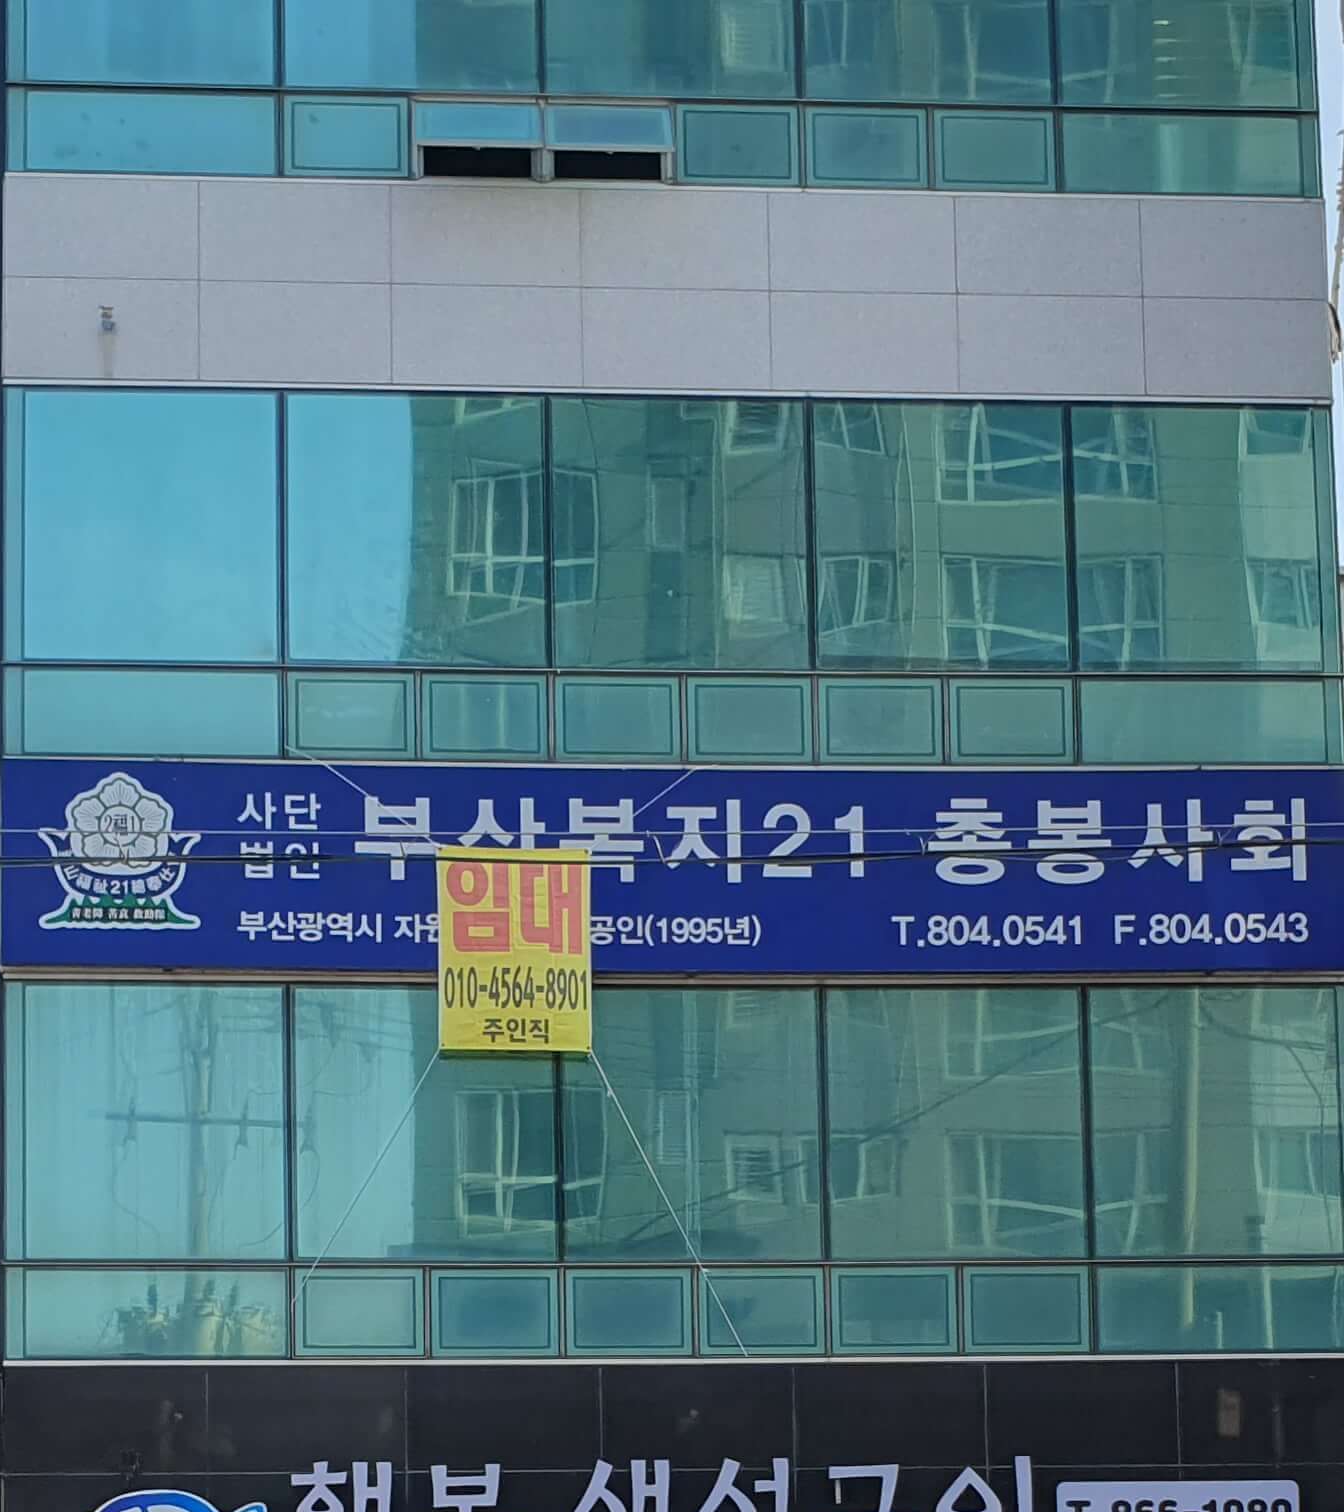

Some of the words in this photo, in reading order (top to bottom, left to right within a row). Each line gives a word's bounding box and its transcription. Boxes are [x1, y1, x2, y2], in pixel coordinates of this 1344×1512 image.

[237, 791, 321, 830] 사단
[239, 841, 320, 879] 법인
[927, 797, 1308, 885] 총봉사회
[447, 862, 583, 955] 임대
[237, 911, 382, 943] 부산광역시
[590, 914, 762, 946] 공인(1995년)
[892, 914, 1083, 947] T.804.0541
[1114, 911, 1309, 946] F.804.0543
[444, 967, 587, 1010] 010-4564-8901
[482, 1018, 550, 1044] 주인직
